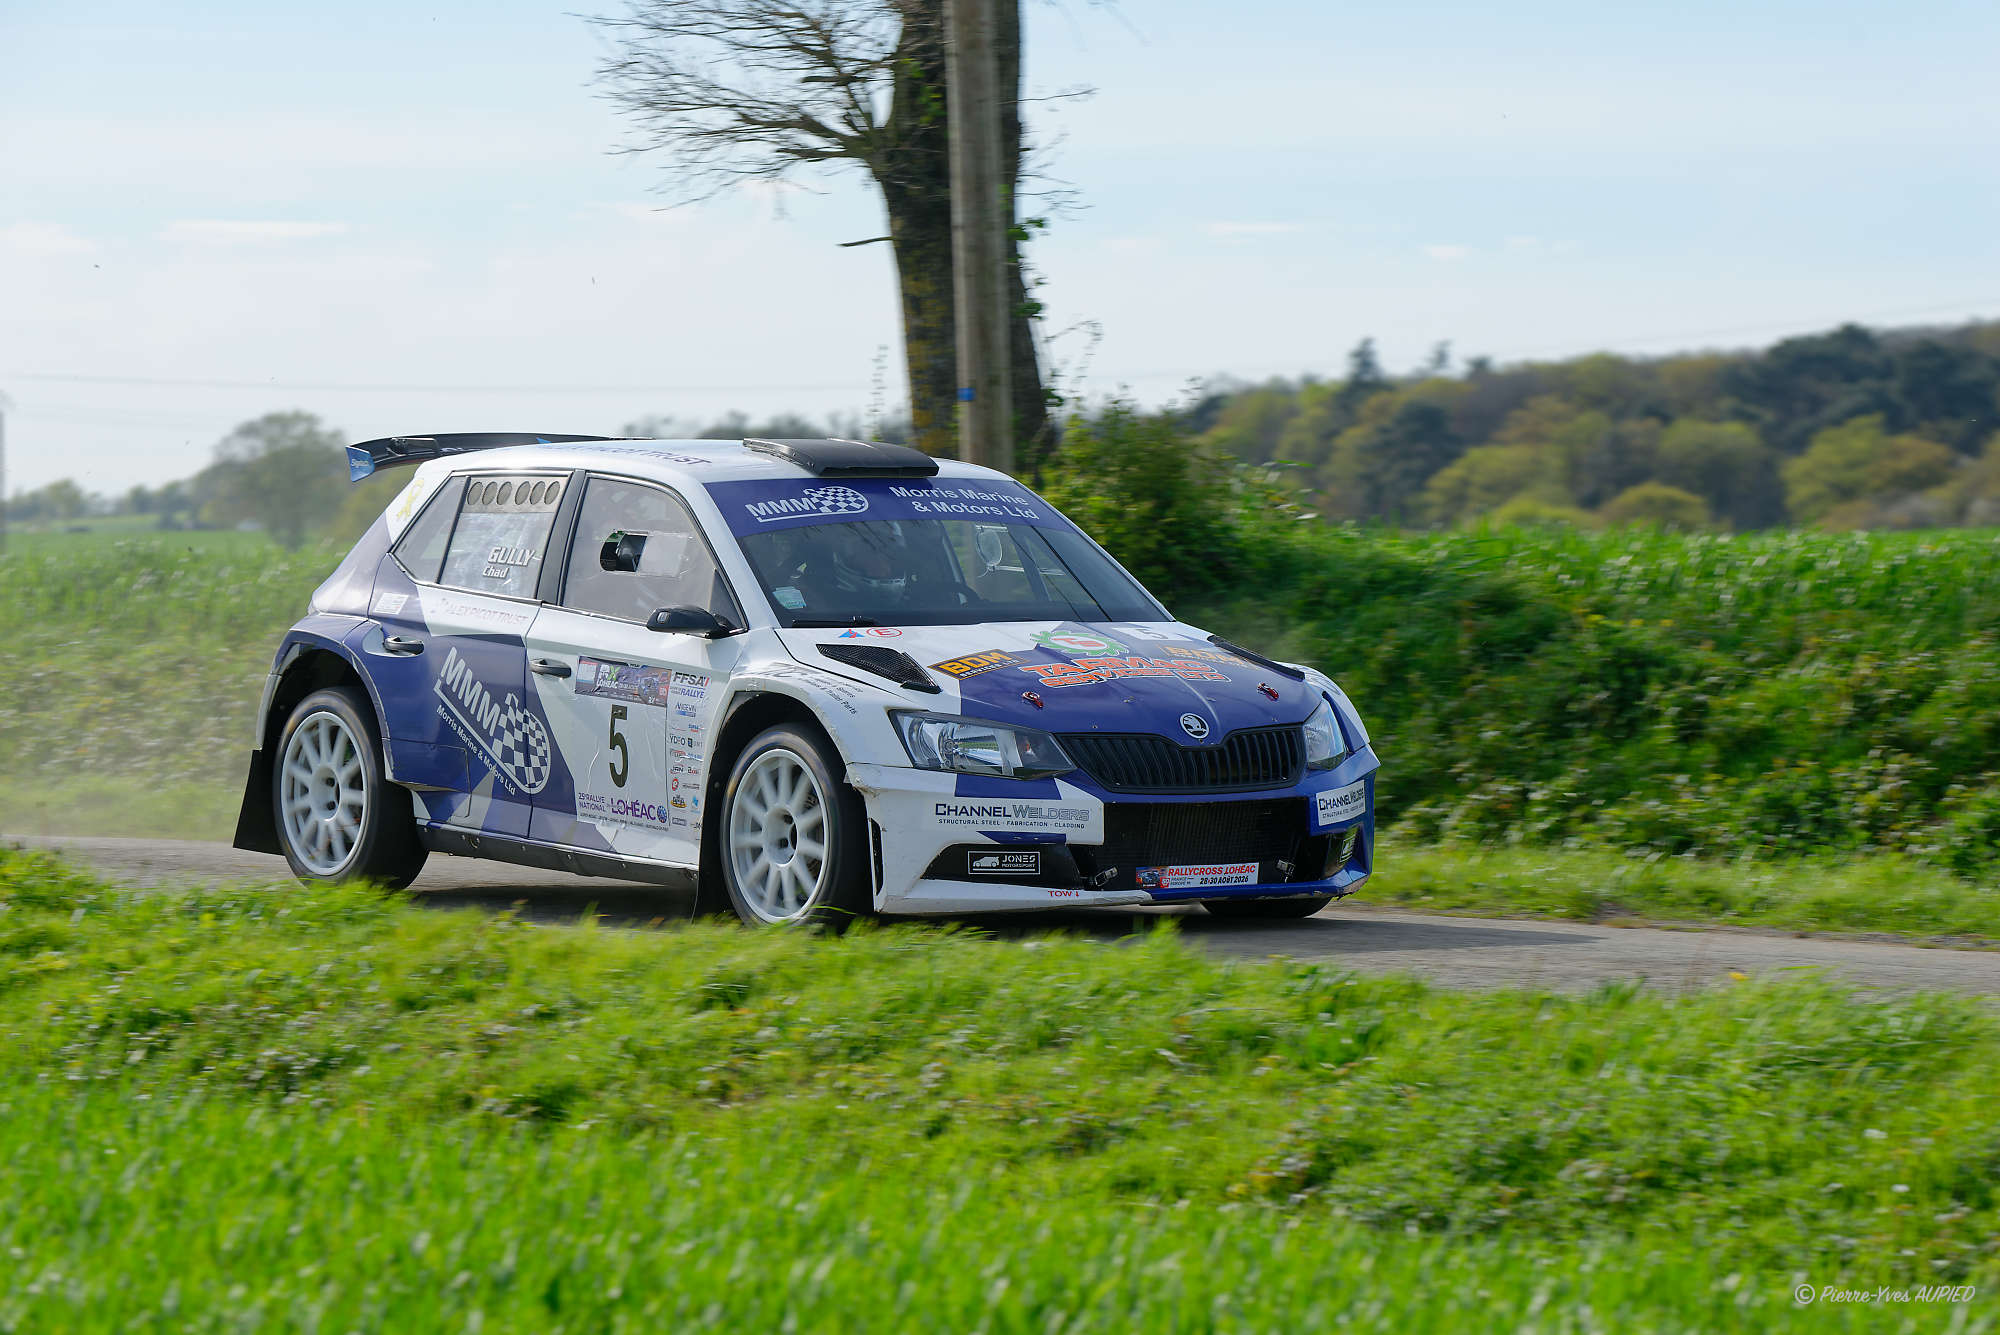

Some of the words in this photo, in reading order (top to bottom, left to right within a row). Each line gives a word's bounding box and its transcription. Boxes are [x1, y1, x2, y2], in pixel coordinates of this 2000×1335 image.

[889, 486, 955, 499] Morris
[959, 488, 1027, 505] Marine
[745, 497, 815, 517] MMM
[914, 501, 929, 512] &
[934, 501, 1002, 516] Motors
[1005, 506, 1040, 519] Ltd
[487, 546, 535, 567] GULLY
[482, 566, 508, 579] Chad
[939, 652, 1013, 674] BDM
[1020, 656, 1214, 678] TARMAC
[1040, 668, 1174, 688] SERVICES
[1177, 671, 1228, 682] LTD
[440, 647, 500, 737] MMM
[680, 688, 705, 699] RALLYE
[436, 704, 458, 731] Morris
[456, 726, 478, 756] Marine
[477, 750, 484, 762] &
[483, 757, 505, 785] Motors
[504, 778, 517, 796] Ltd
[609, 704, 629, 788] 5
[578, 801, 606, 812] NATIONAL
[611, 798, 656, 820] LOHÉAC
[935, 803, 1011, 818] CHANNEL
[1012, 804, 1090, 821] WELDERS
[1002, 854, 1036, 863] JONES
[1168, 866, 1222, 877] RALLYCROSS
[1234, 875, 1249, 883] 2026
